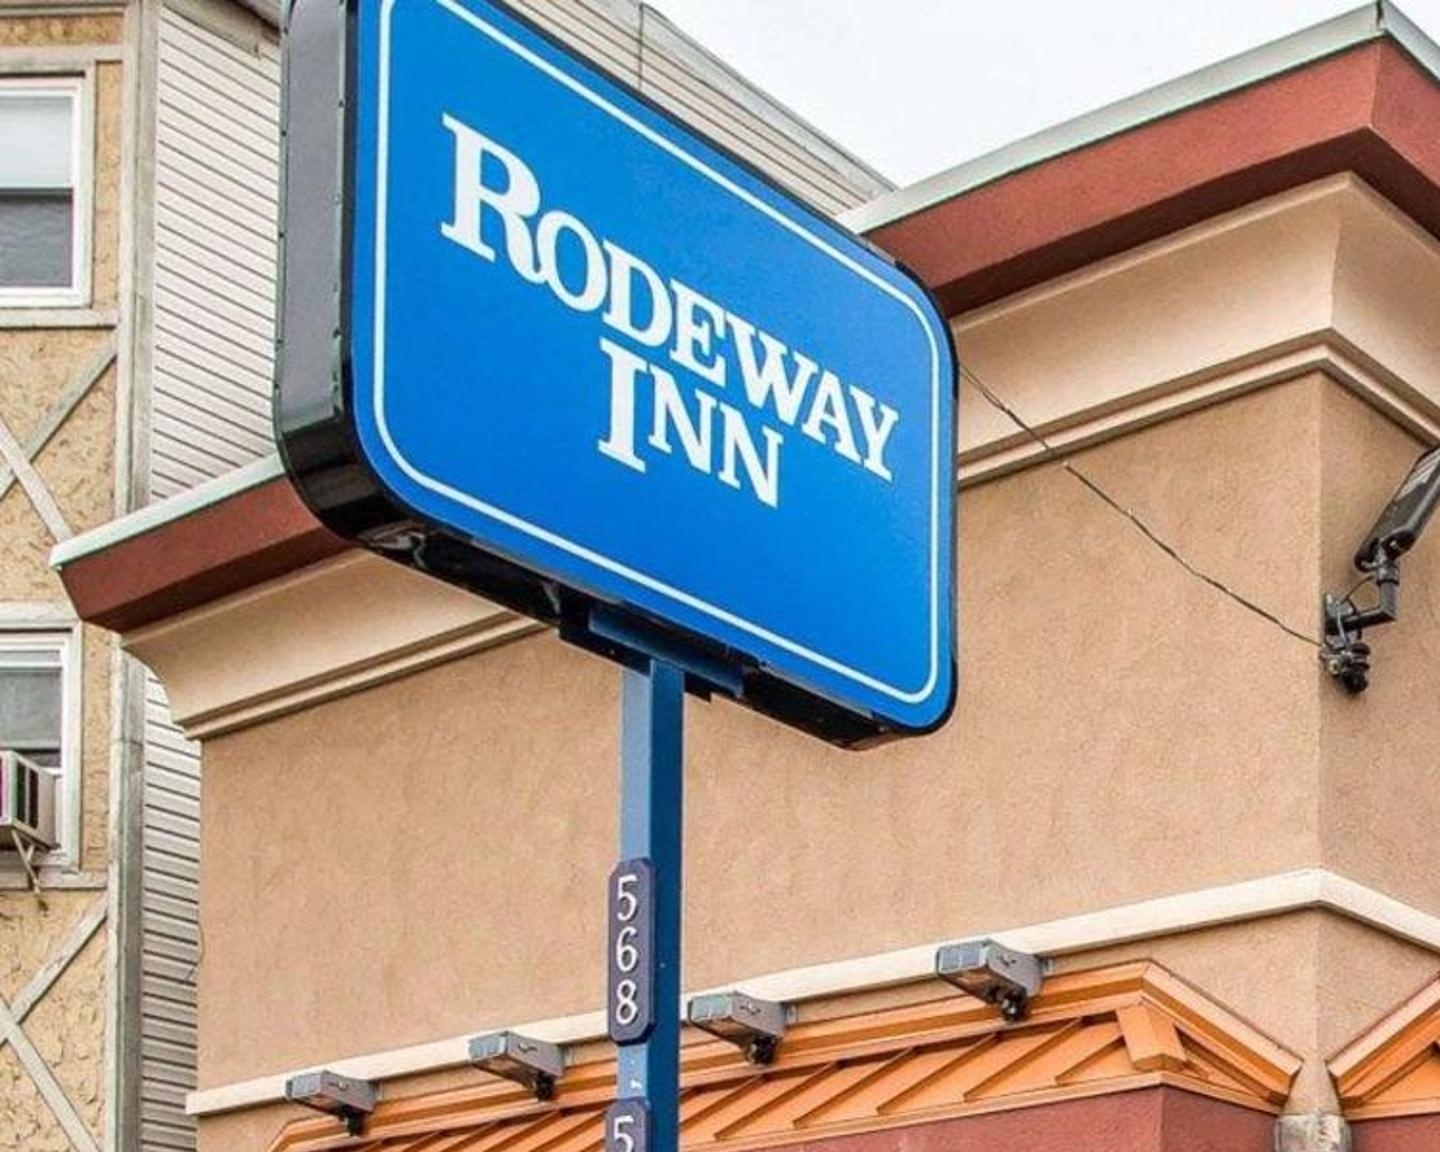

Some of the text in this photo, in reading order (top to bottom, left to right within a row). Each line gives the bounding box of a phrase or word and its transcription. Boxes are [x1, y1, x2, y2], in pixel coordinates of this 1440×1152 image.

[441, 114, 899, 481] RODEWAY
[598, 338, 783, 507] INN
[615, 873, 638, 1026] 568
